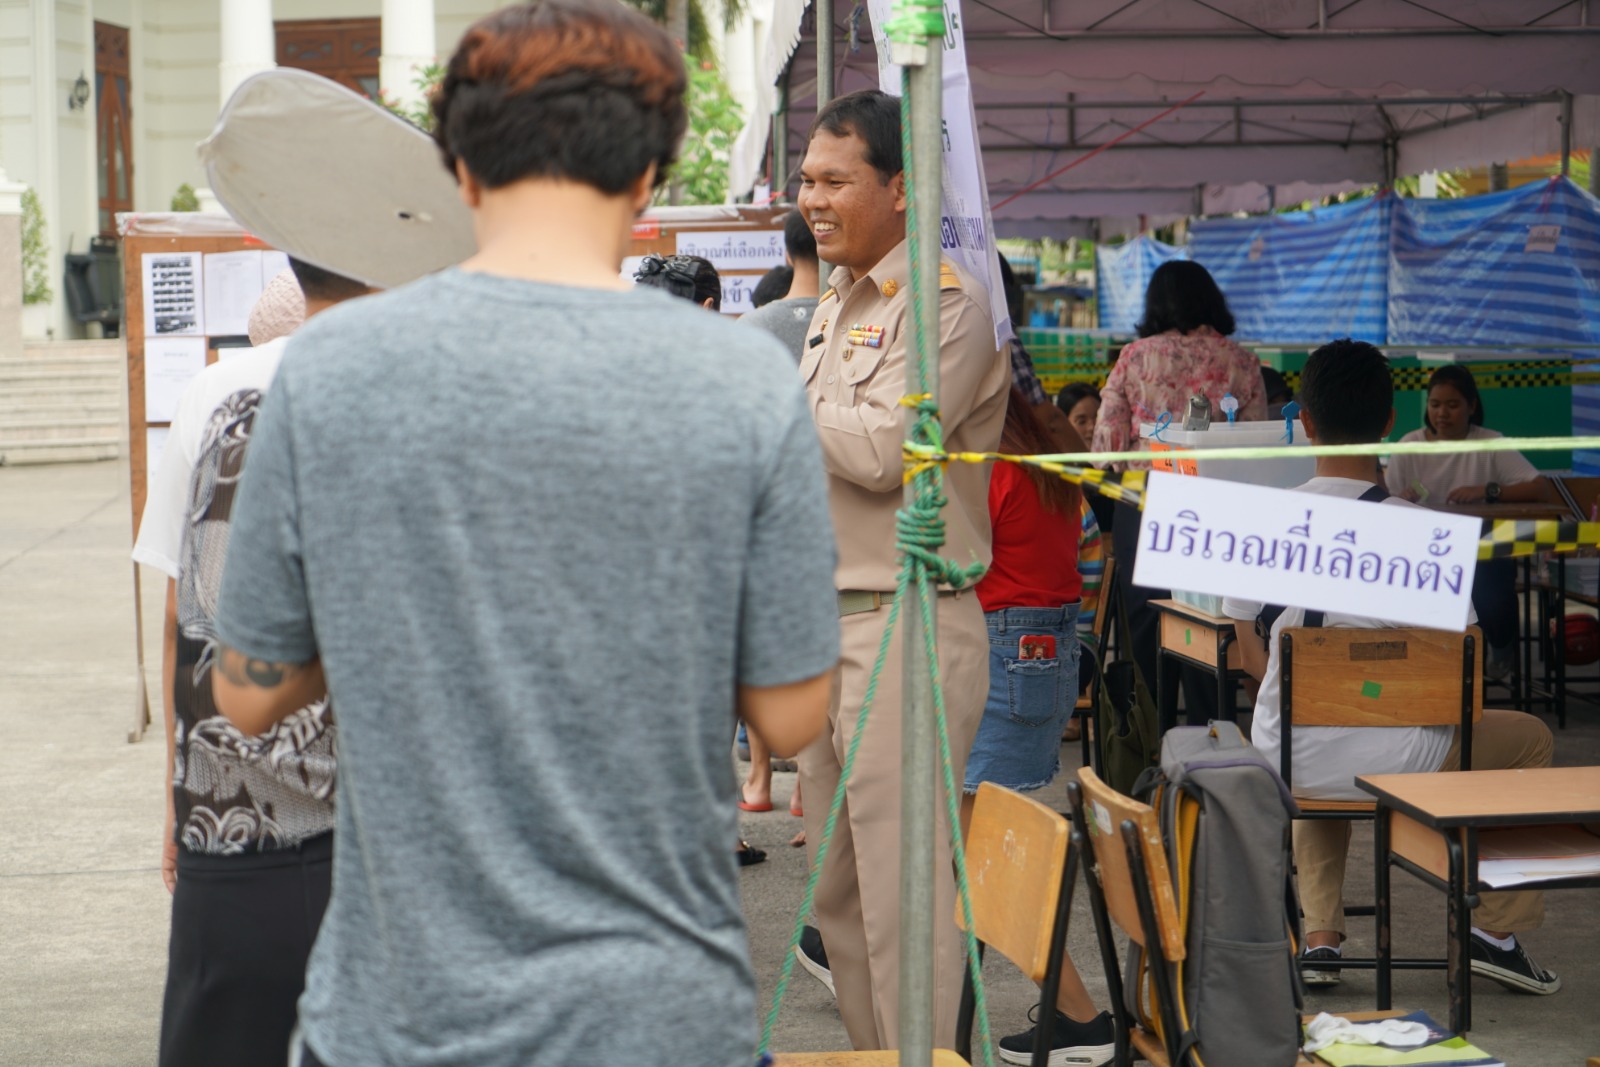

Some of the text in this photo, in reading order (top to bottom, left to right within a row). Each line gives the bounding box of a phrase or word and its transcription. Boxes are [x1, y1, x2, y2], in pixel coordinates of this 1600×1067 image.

[1147, 508, 1464, 596] บริเวณที่เลือกตั้ง
